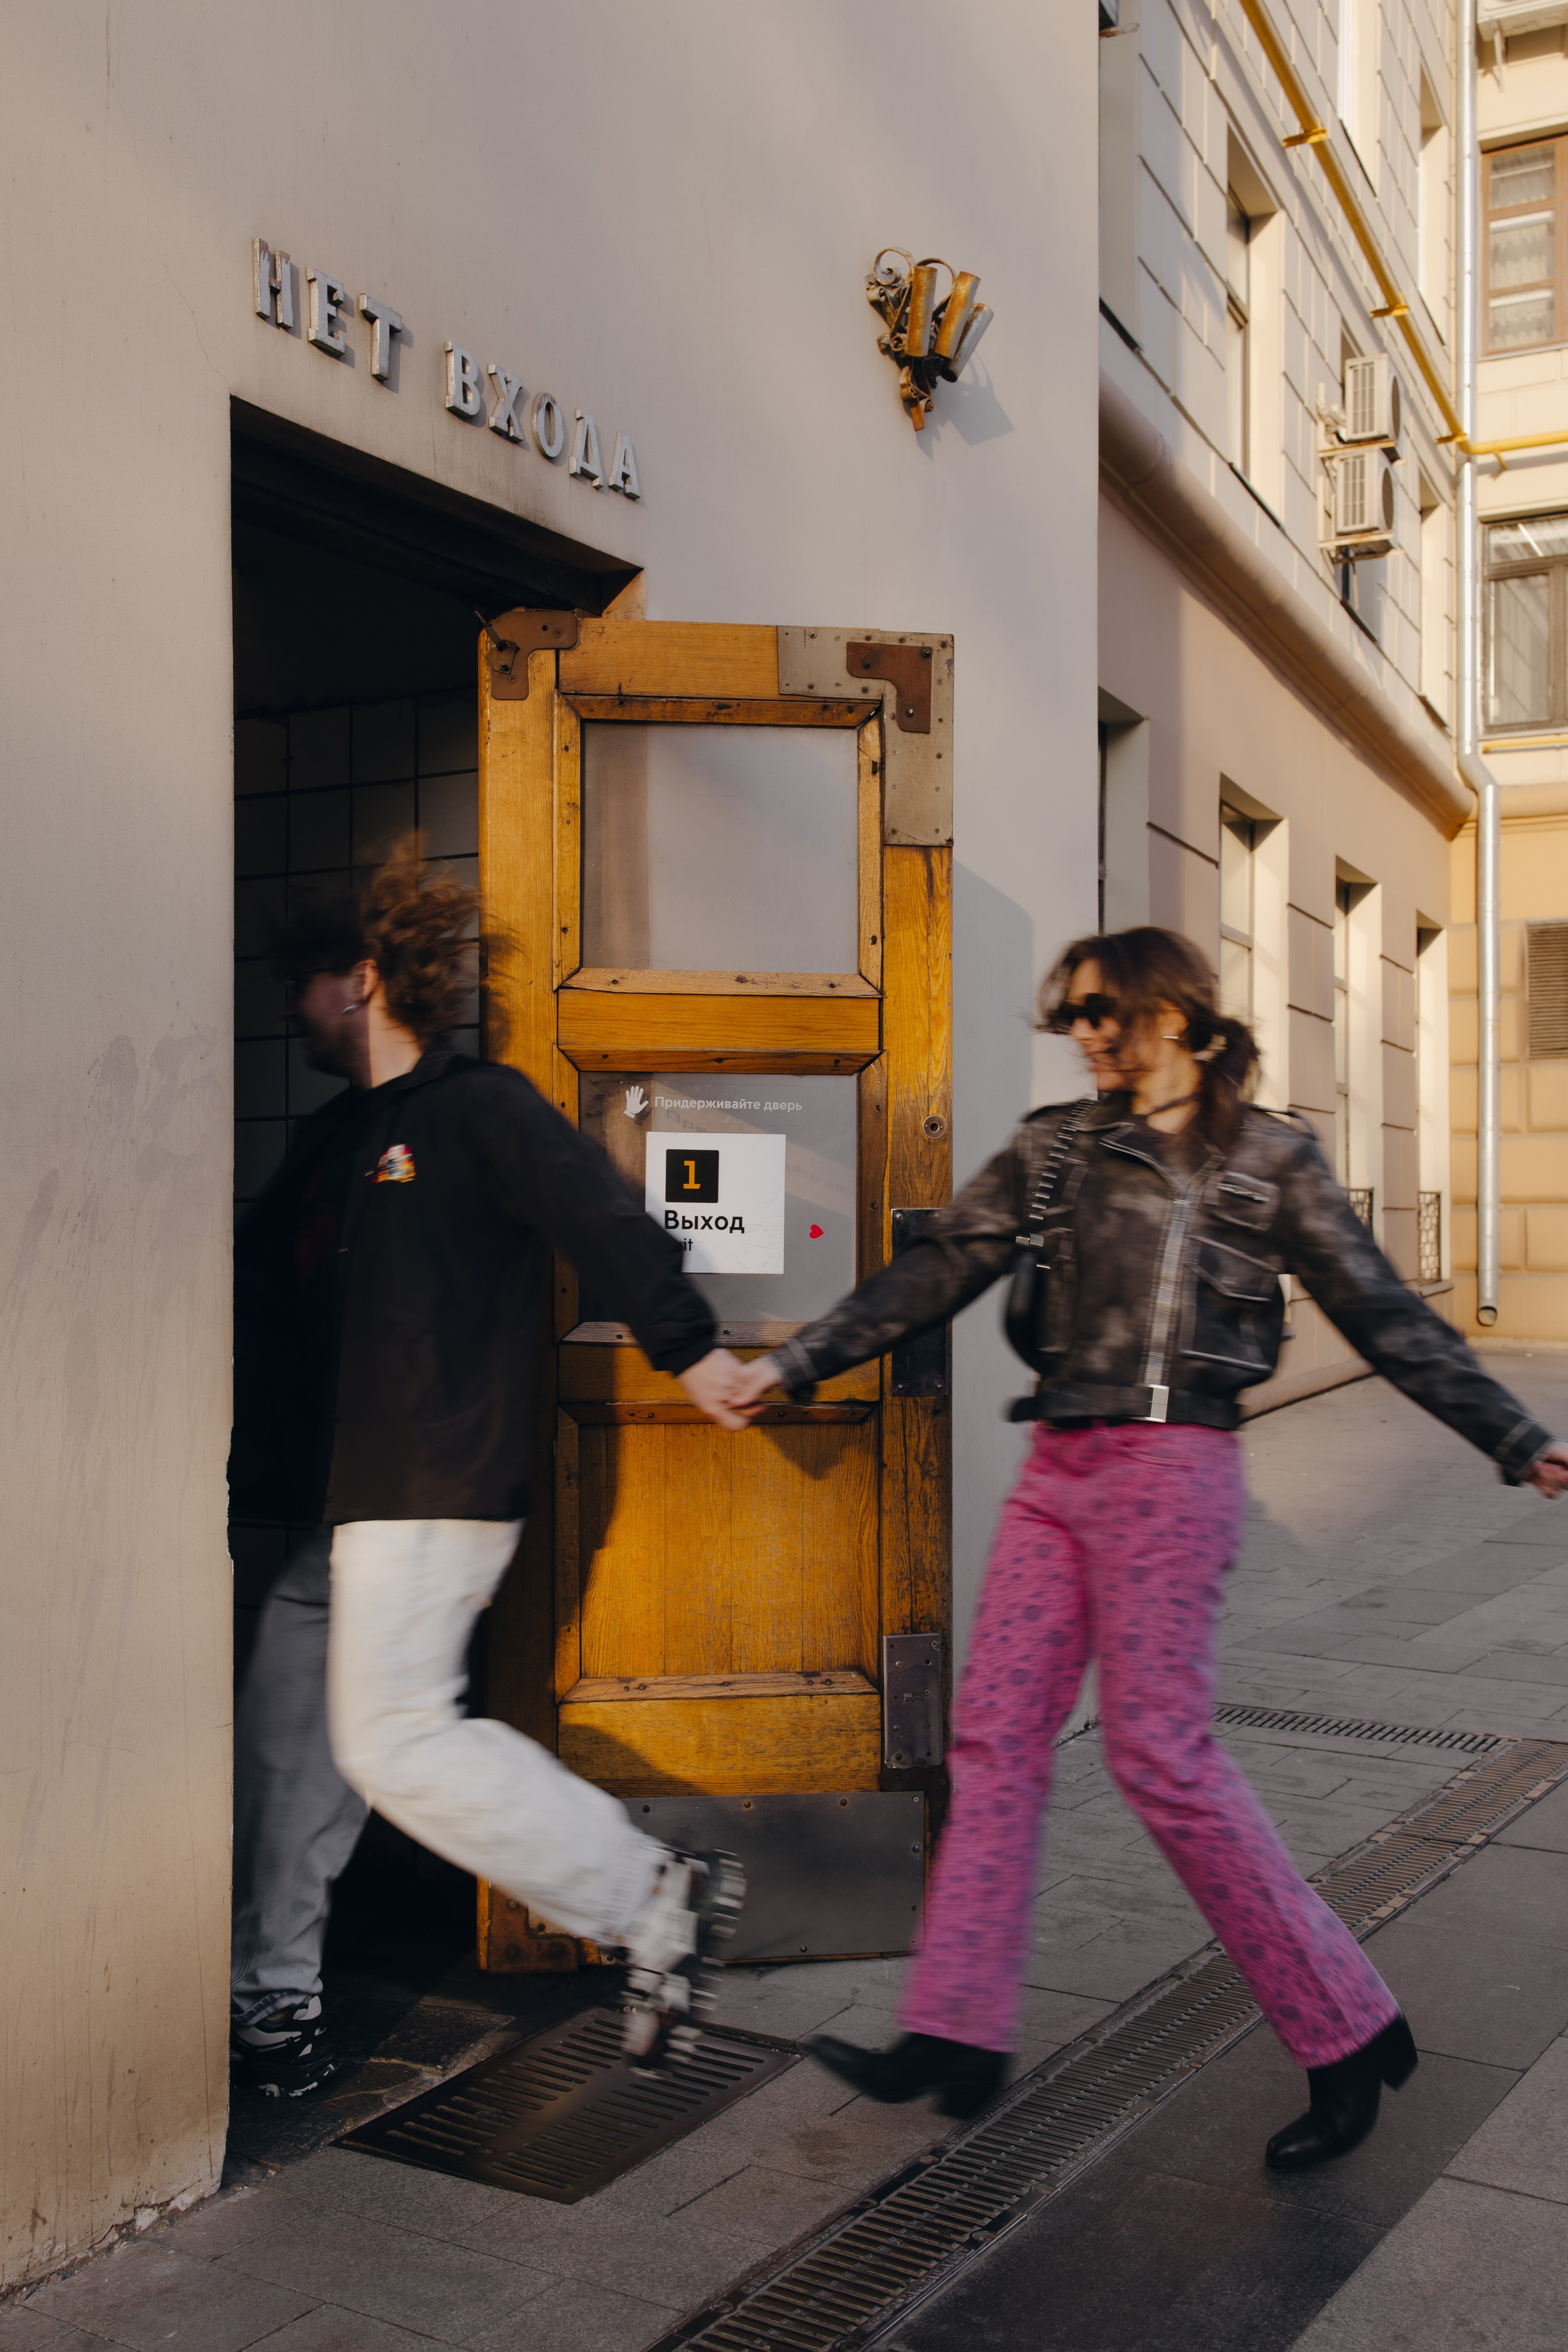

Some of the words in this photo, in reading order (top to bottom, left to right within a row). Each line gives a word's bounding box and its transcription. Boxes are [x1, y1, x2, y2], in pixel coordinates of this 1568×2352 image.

[252, 237, 402, 382] НЕТ
[444, 341, 641, 500] ВХОДА
[654, 1096, 761, 1110] Придерживайте
[763, 1100, 802, 1112] дверь
[683, 1160, 701, 1189] 1
[665, 1210, 745, 1234] Выход
[680, 1238, 693, 1251] it
